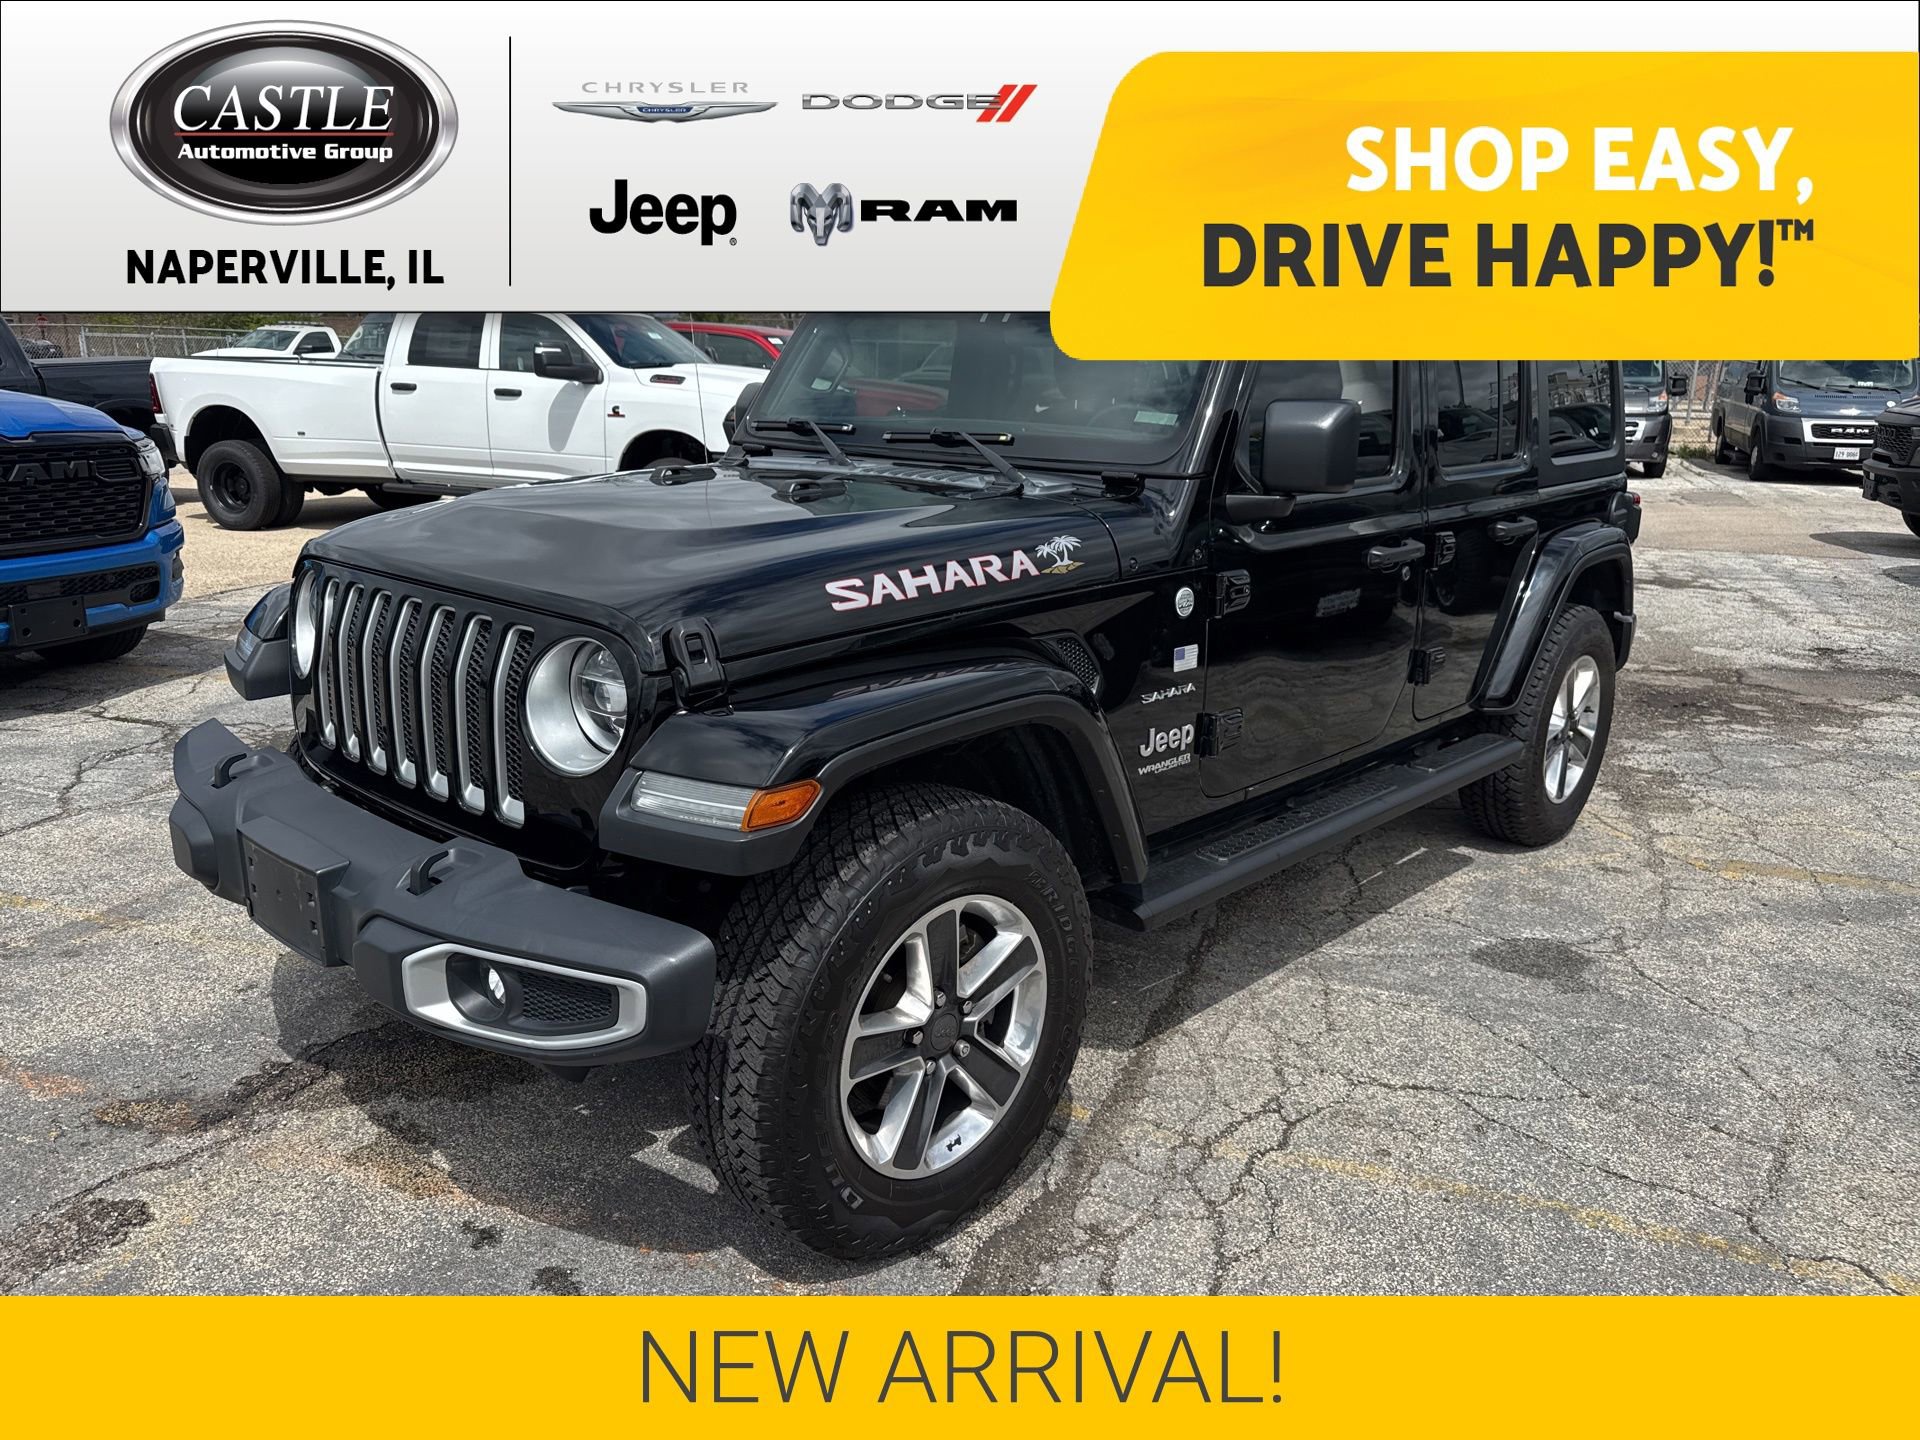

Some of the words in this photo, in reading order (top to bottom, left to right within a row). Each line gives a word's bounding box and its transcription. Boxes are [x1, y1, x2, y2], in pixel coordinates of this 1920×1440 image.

[0, 460, 89, 482] AM
[825, 548, 1041, 612] SAHARA
[1140, 682, 1197, 704] SAHARA
[1139, 723, 1195, 757] Jeep
[1137, 752, 1191, 775] WRANGLER
